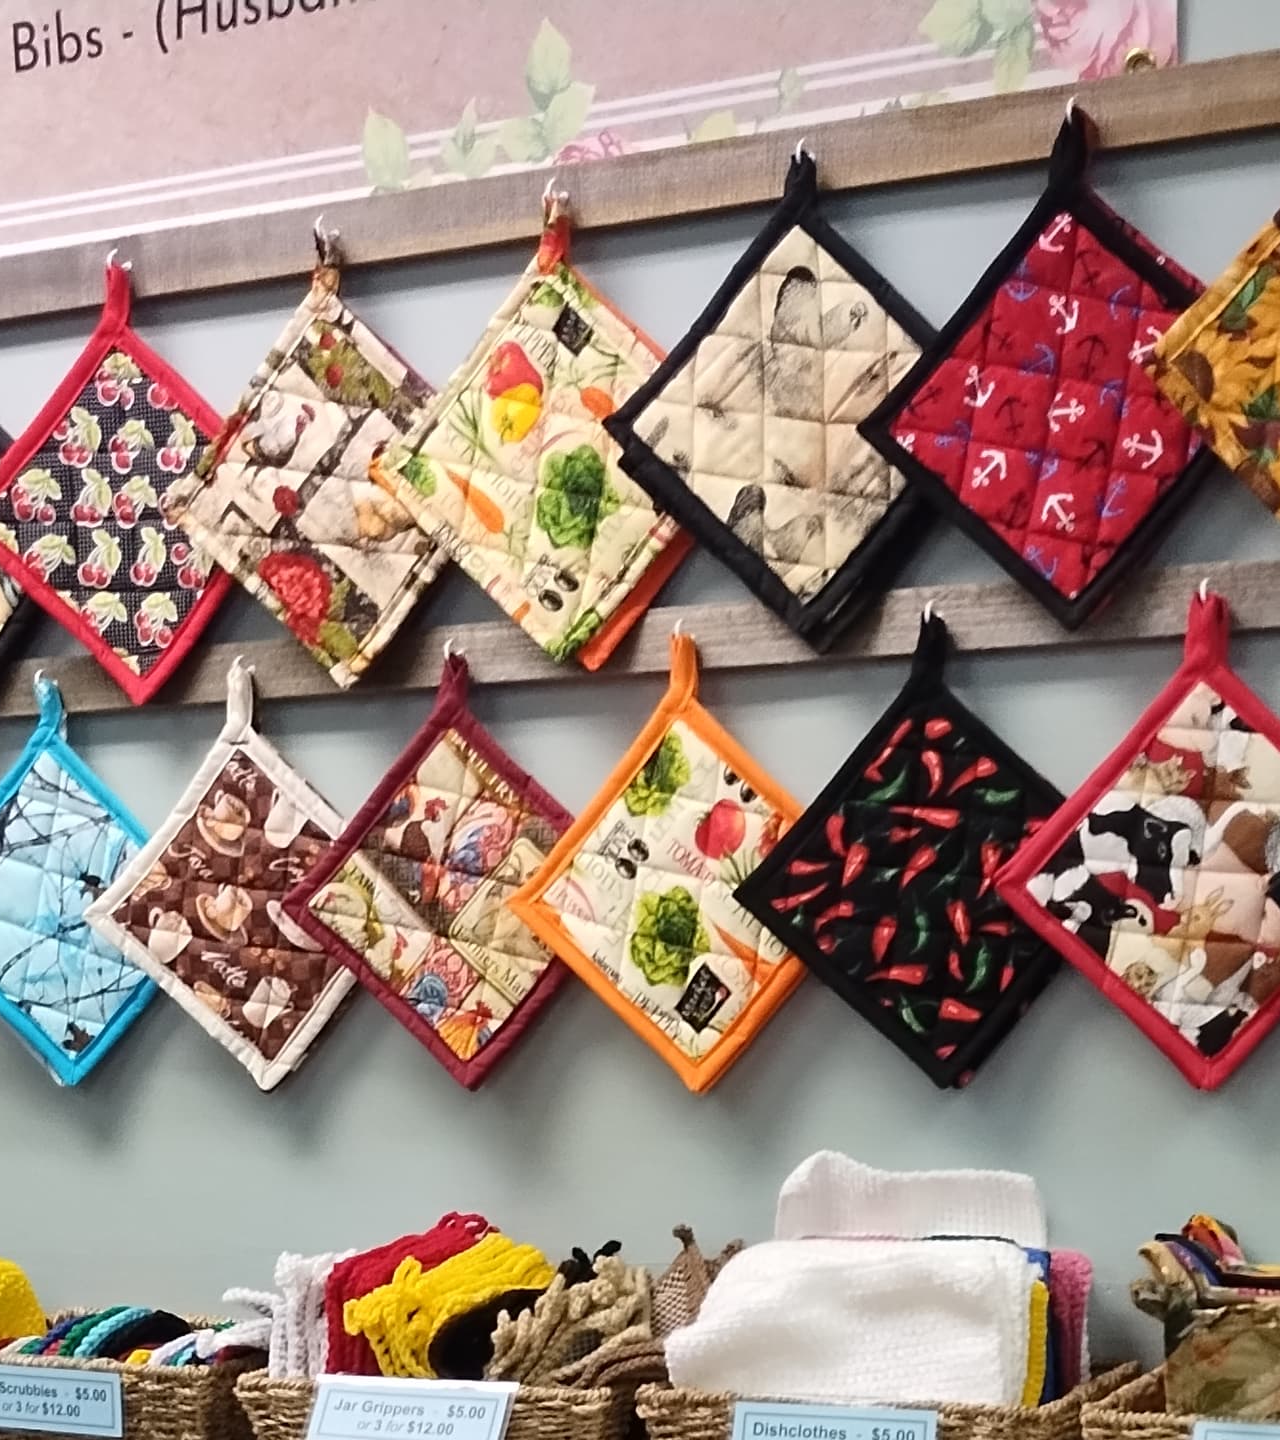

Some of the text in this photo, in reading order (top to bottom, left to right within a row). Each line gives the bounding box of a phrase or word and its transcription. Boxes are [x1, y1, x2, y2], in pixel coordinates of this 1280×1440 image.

[12, 9, 104, 73] Bibs
[75, 1387, 107, 1402] $5.00
[1, 1401, 81, 1417] or 3 for $12.00
[333, 1399, 486, 1420] Jar Grippers $5.00
[356, 1419, 454, 1436] or 3 for $12.00
[752, 1421, 847, 1440] Dishclothes
